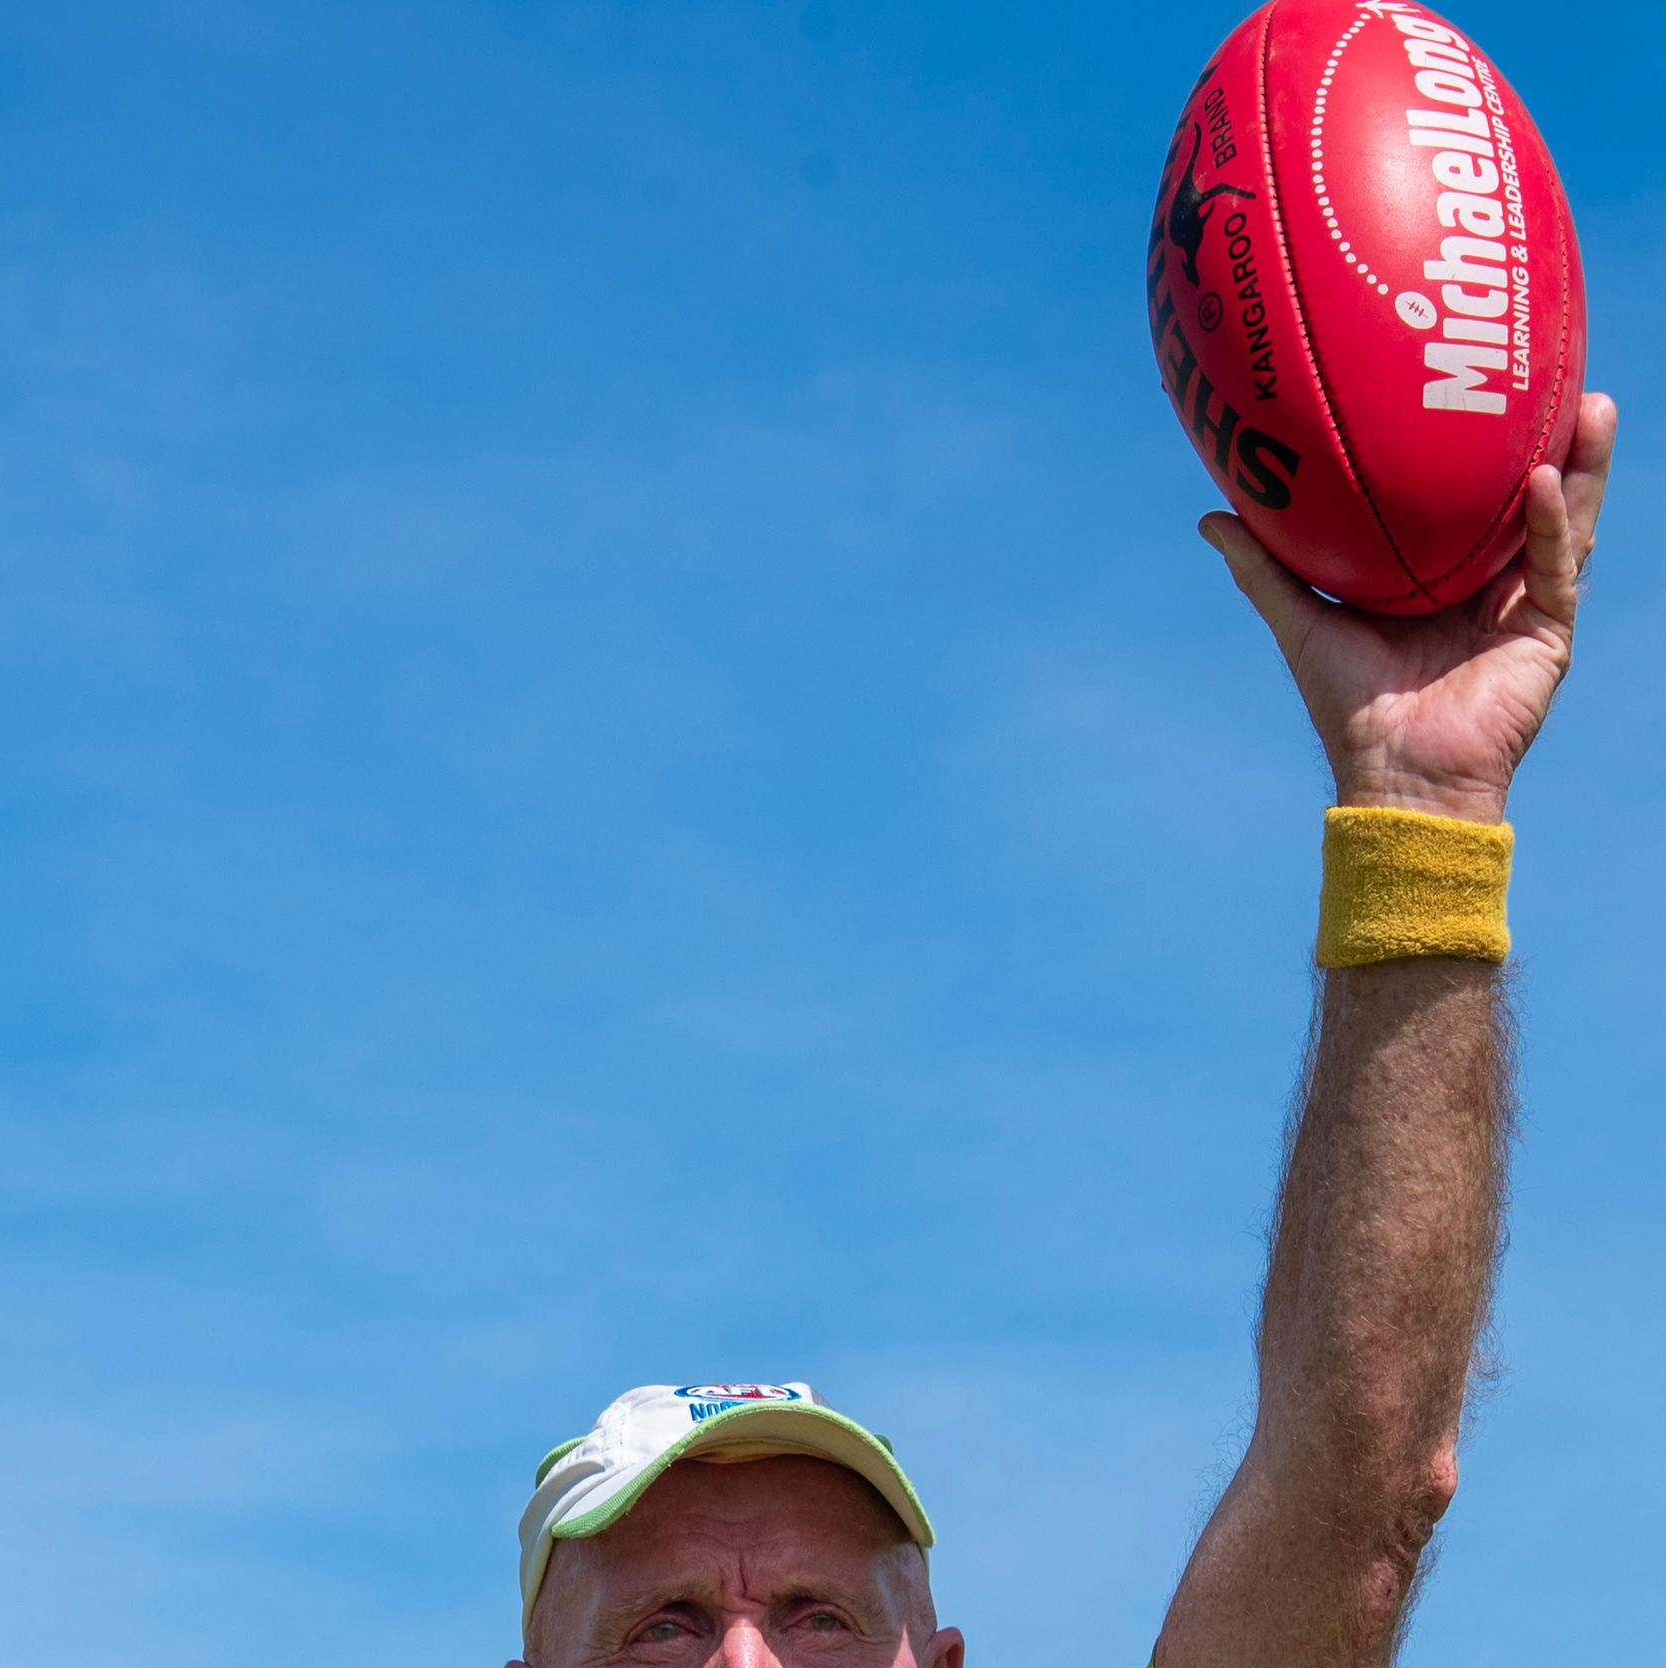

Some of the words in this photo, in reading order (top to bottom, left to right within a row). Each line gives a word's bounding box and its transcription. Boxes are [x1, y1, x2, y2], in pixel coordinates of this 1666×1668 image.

[1203, 87, 1237, 170] BRAND
[1470, 55, 1505, 115] CENTRE
[1491, 115, 1527, 240] LEADERSHIP
[1510, 244, 1529, 263] &
[1223, 211, 1278, 401] KANGAROO
[1512, 265, 1530, 391] LEARNING
